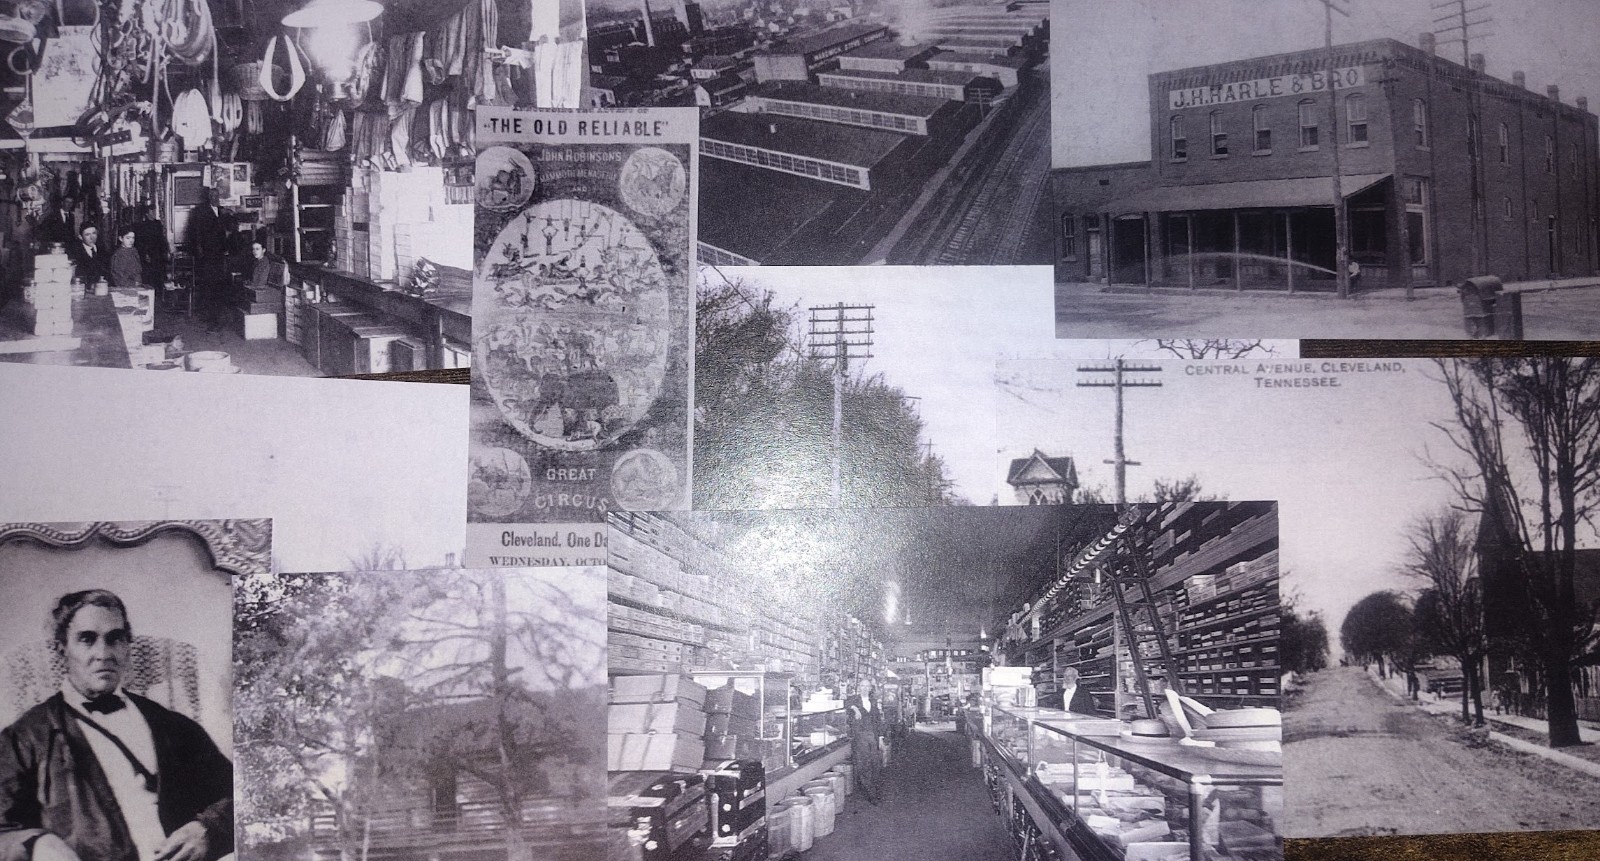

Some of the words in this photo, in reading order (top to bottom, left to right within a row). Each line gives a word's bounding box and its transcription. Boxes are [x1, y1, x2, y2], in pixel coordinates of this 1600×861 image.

[1291, 76, 1303, 93] &
[1312, 68, 1358, 91] BRO
[534, 119, 568, 136] OLD
[1185, 364, 1249, 376] CENTRAL
[546, 468, 597, 481] GREAT
[535, 494, 609, 512] CIRCUS
[567, 531, 591, 548] One
